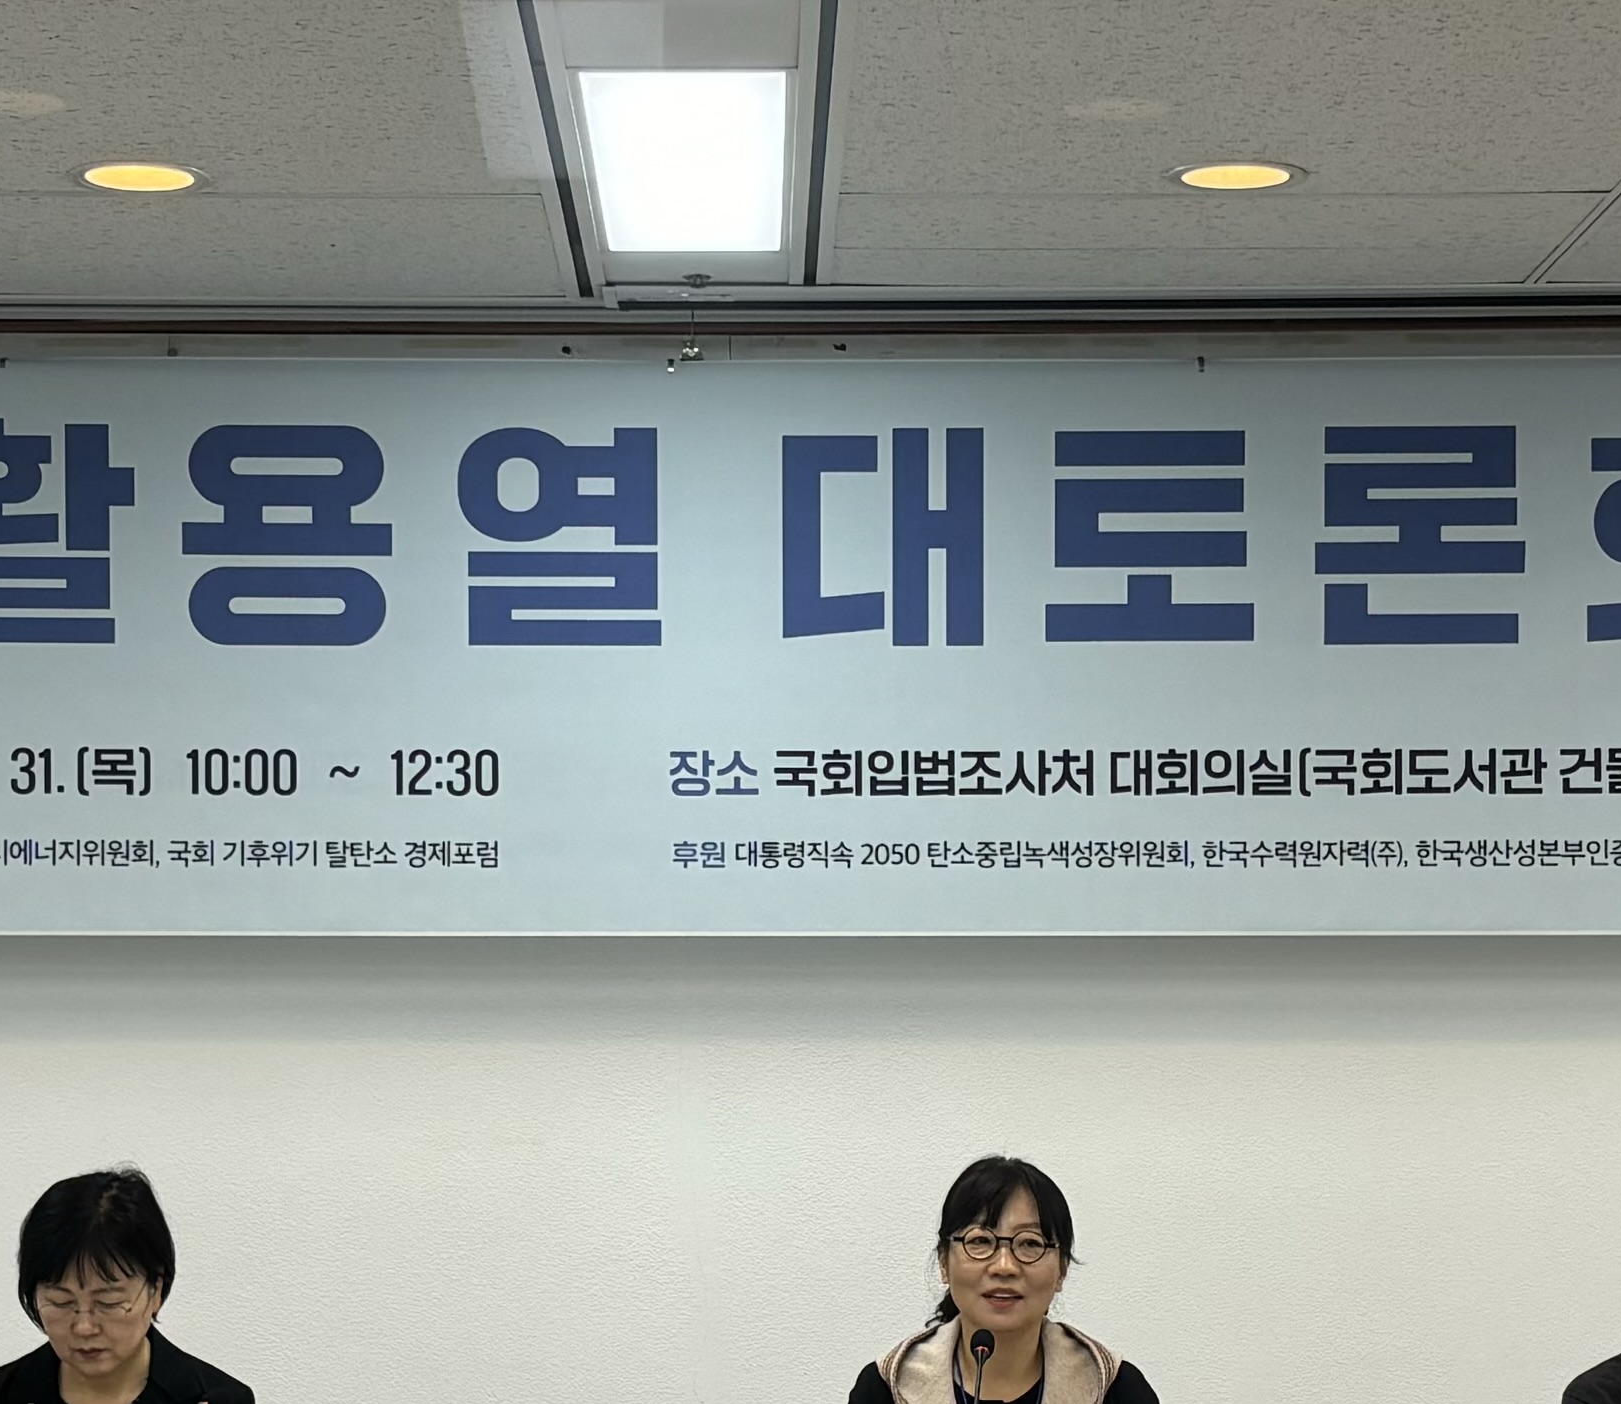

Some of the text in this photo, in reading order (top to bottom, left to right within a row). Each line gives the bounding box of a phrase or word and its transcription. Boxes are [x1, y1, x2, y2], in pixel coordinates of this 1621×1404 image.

[186, 748, 297, 796] 10:00
[329, 765, 360, 778] ~
[390, 749, 499, 797] 12:30
[669, 750, 760, 797] 장소
[773, 748, 1094, 797] 국회입법조사처
[1110, 747, 1548, 797] 대회의실(국회도서관
[167, 839, 214, 868] 국회
[222, 839, 318, 868] 기후위기
[325, 840, 398, 869] 탈탄소
[404, 840, 499, 869] 경제포럼
[672, 840, 726, 869] 후원
[735, 840, 854, 869] 대통령직속
[860, 843, 920, 866] 2050
[927, 840, 1195, 869] 탄소중립녹색성장위원회,
[1201, 839, 1408, 869] 한국수력원자력(주),
